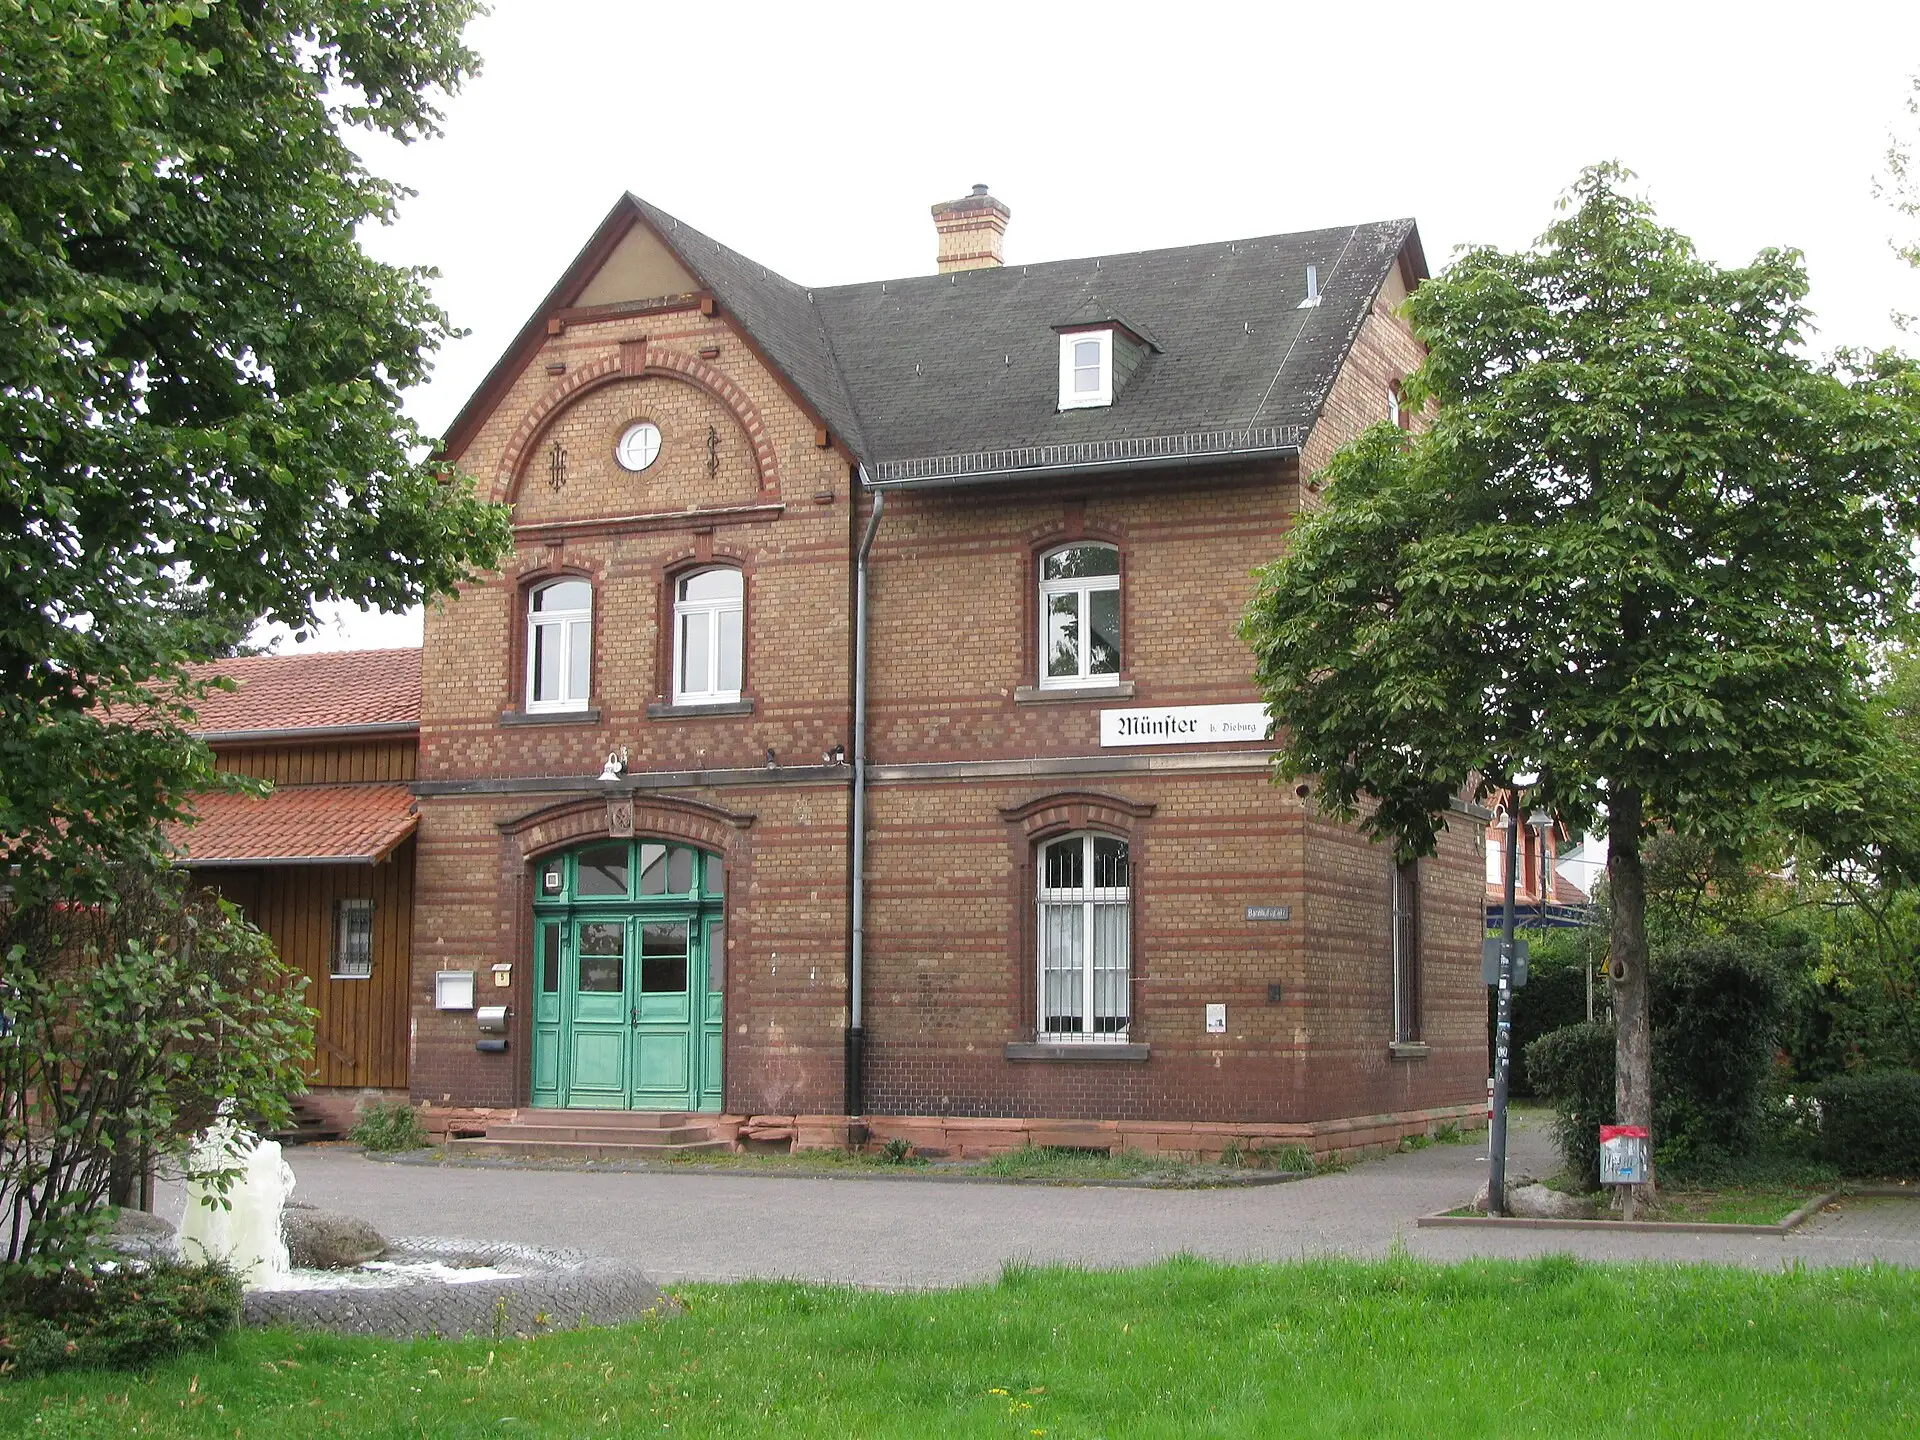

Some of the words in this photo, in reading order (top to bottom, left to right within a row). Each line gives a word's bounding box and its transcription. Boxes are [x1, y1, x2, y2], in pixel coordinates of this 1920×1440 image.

[1117, 715, 1198, 739] Münster
[1222, 722, 1257, 734] Dieburg
[500, 973, 505, 981] 5
